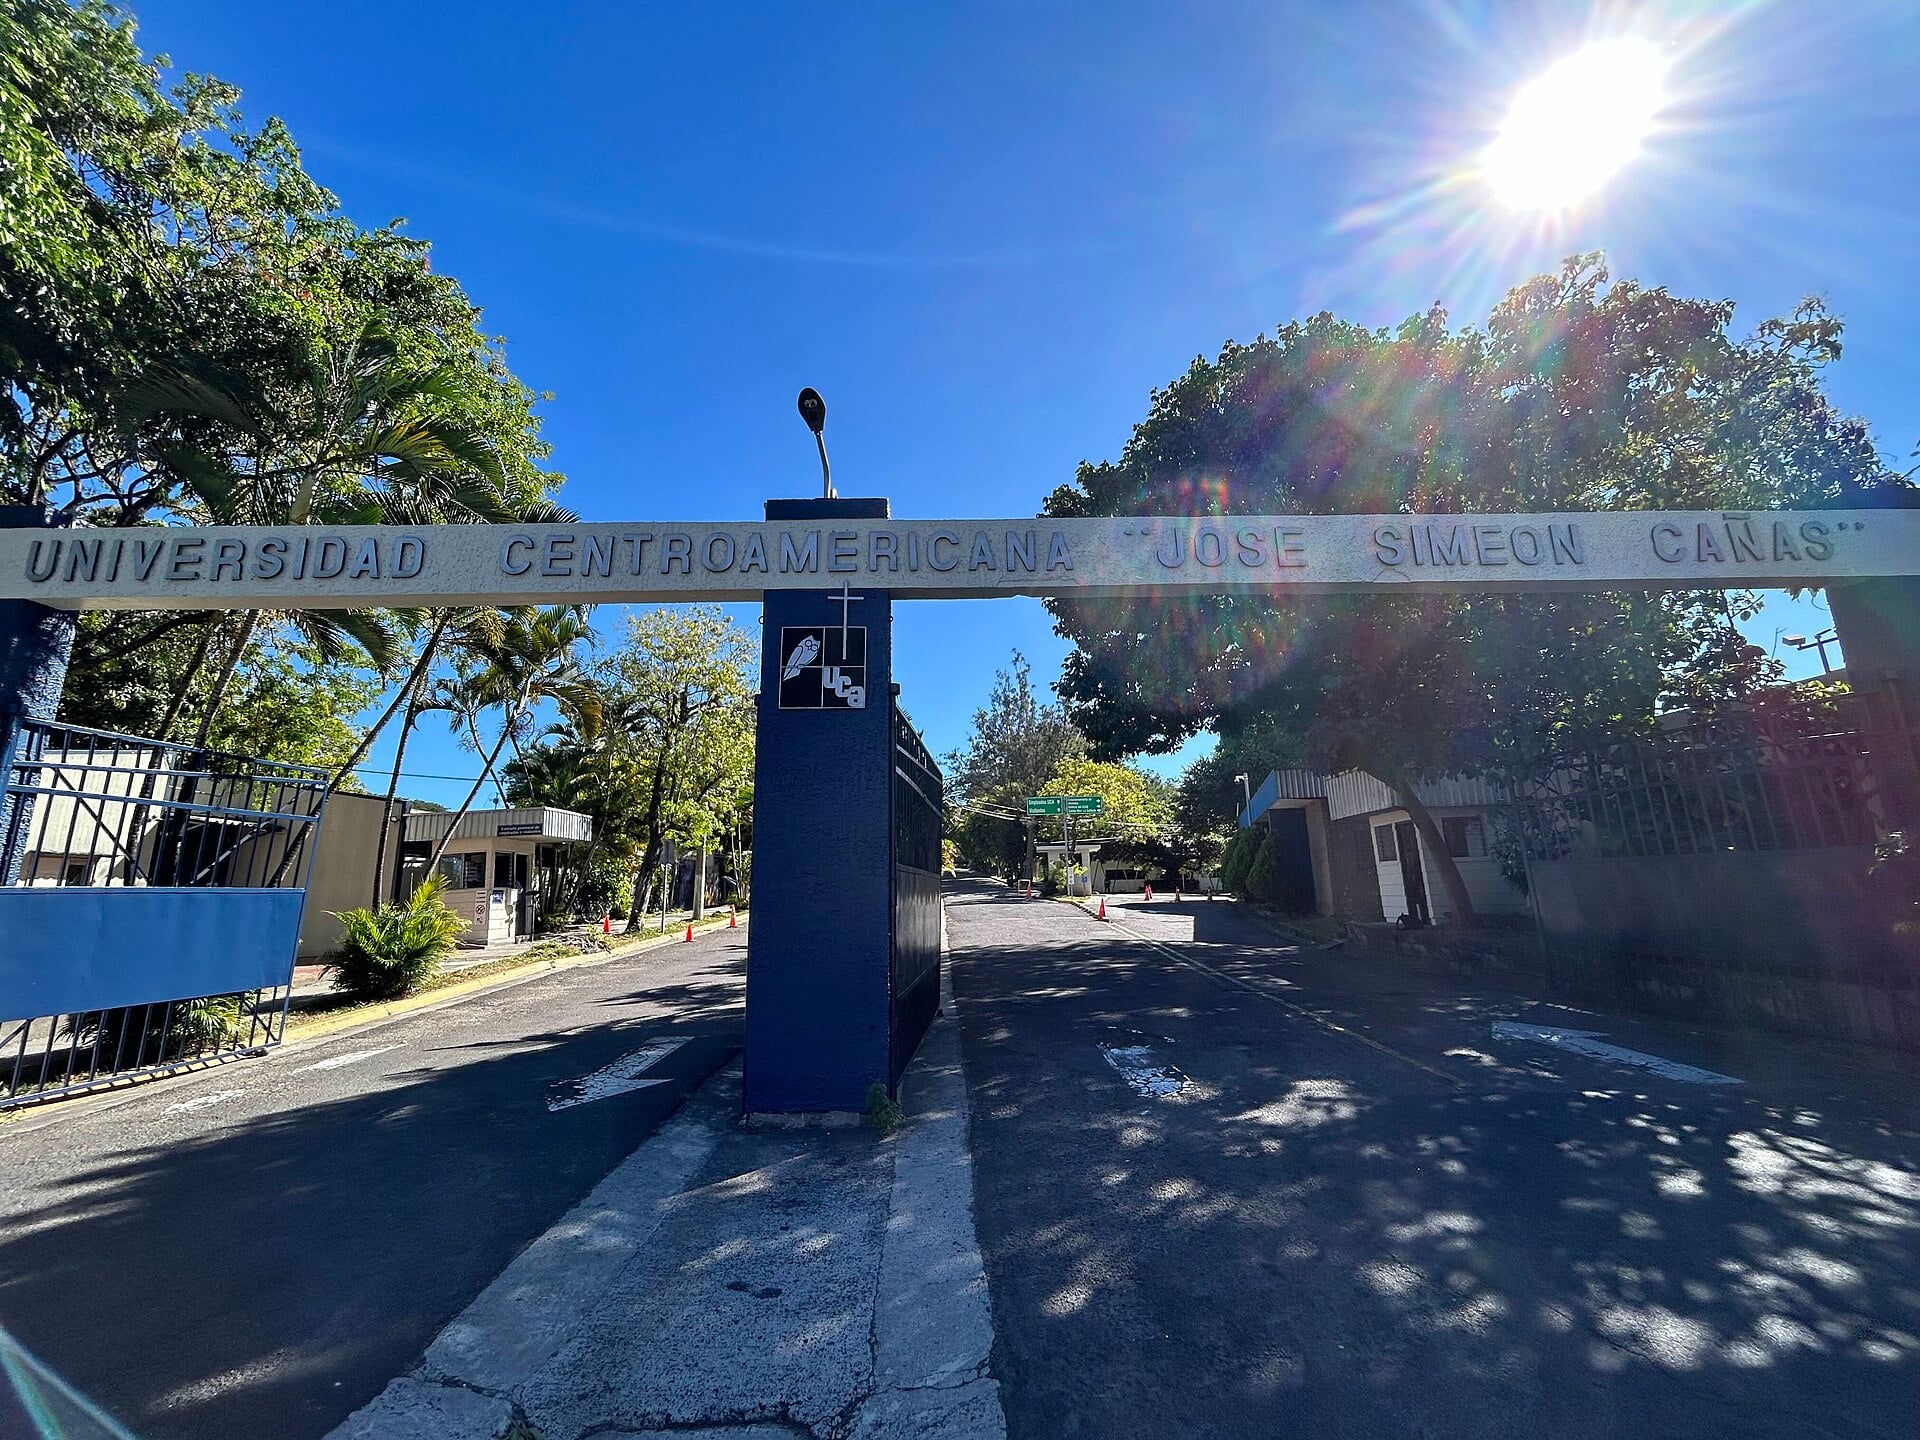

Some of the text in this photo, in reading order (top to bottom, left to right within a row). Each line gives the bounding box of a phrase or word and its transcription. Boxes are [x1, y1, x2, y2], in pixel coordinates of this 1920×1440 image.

[24, 535, 426, 582] UNIVERSIDAD
[500, 530, 1075, 577] CENTROAMERICANA
[1373, 523, 1584, 566] SIMEON
